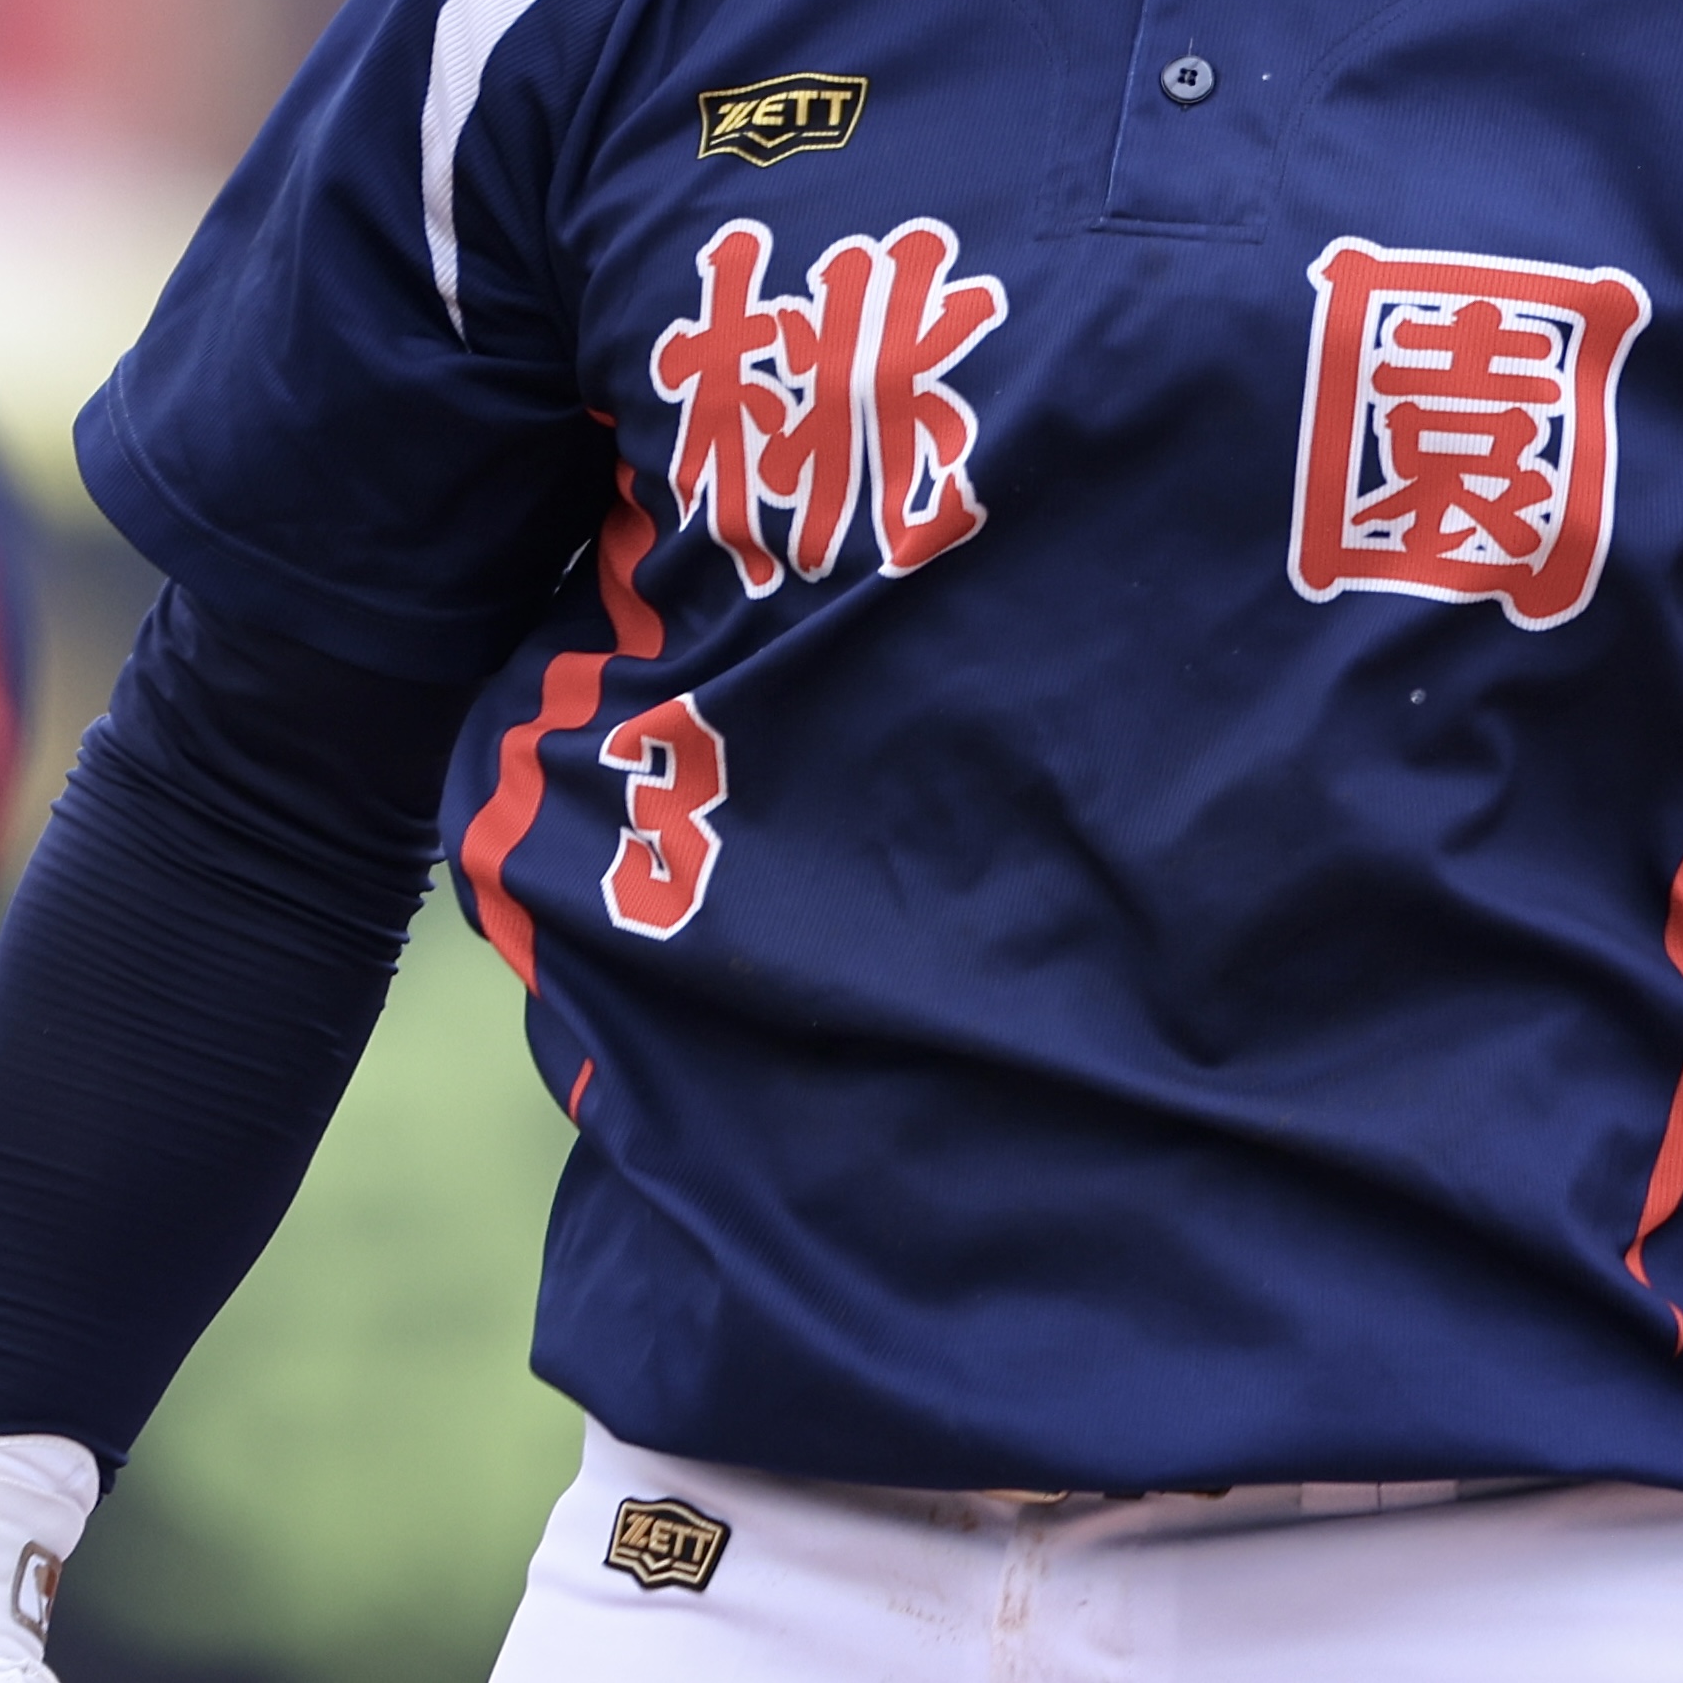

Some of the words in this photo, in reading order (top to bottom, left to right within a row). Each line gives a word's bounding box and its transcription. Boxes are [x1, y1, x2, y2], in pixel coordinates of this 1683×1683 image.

[711, 90, 853, 137] ZETT
[600, 693, 727, 941] 3
[619, 1512, 714, 1563] ZETT
